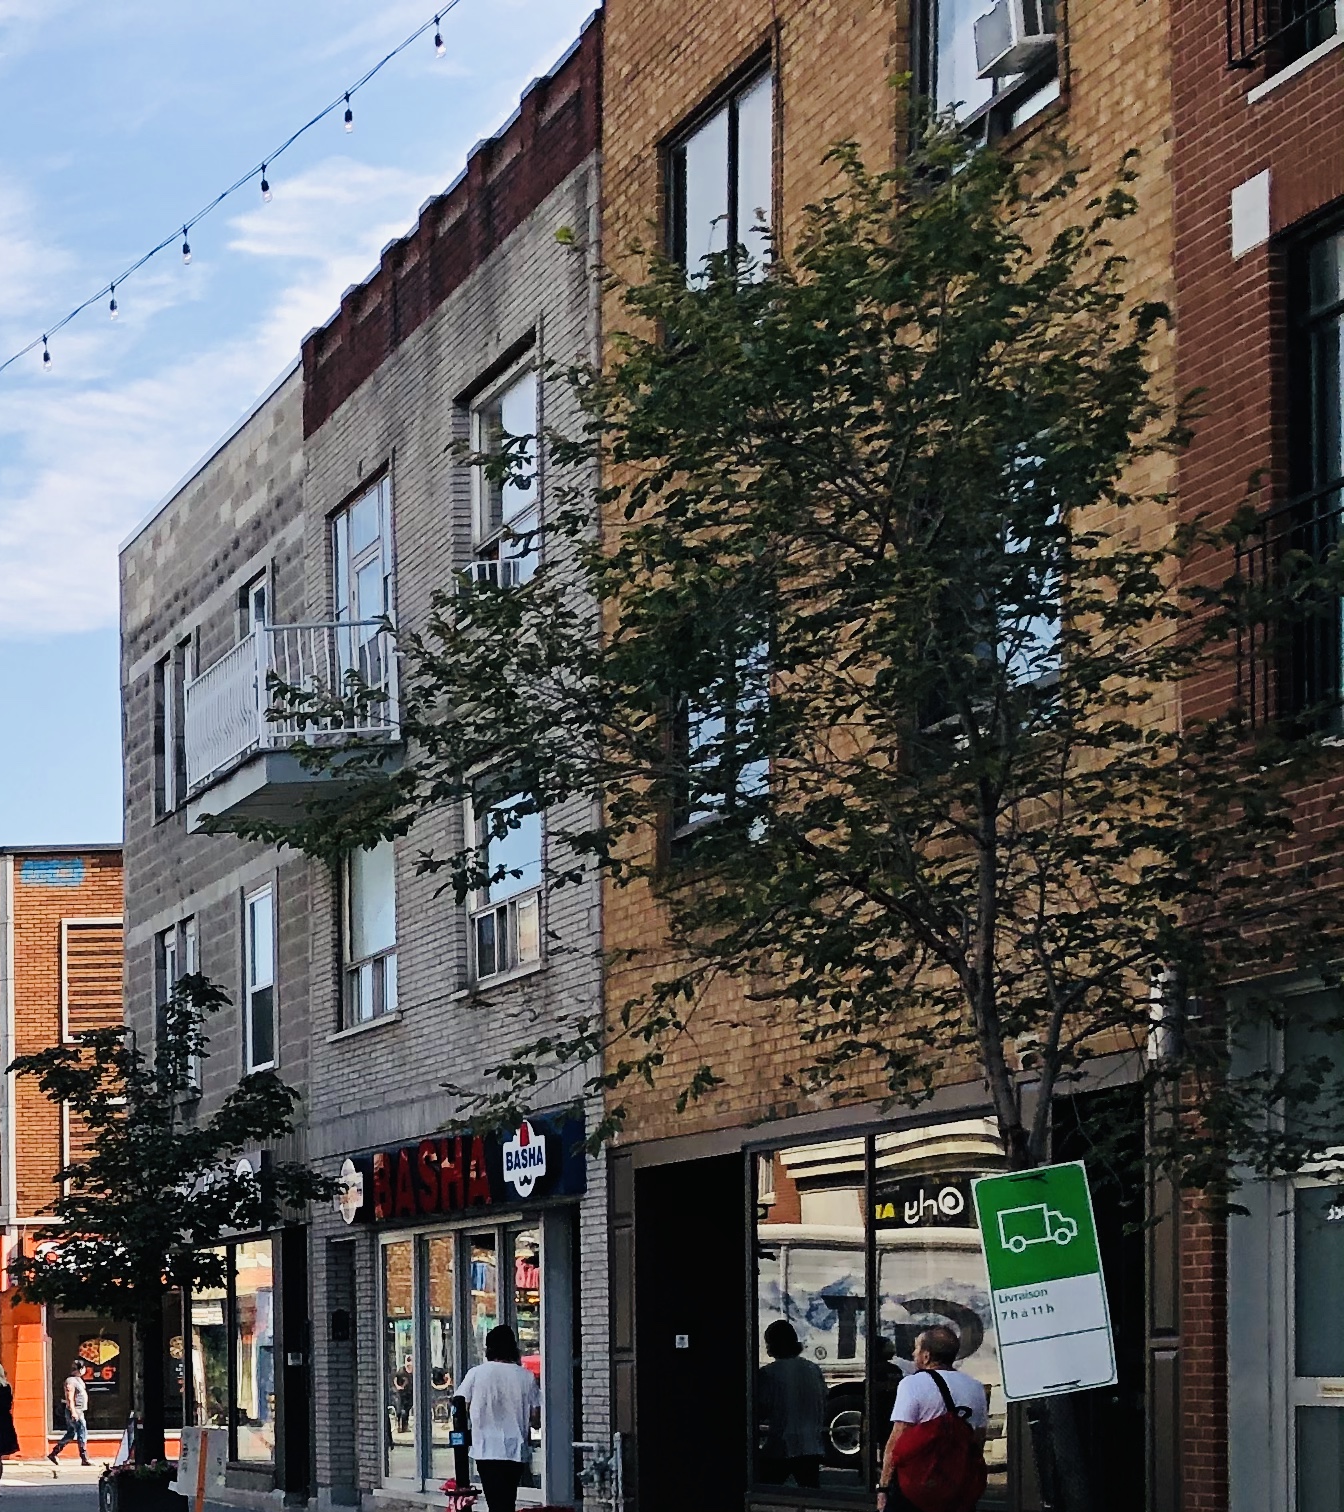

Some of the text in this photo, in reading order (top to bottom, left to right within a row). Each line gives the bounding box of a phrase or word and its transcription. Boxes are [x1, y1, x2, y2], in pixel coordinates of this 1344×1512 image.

[505, 1145, 545, 1172] BASHA
[373, 1133, 494, 1221] BASHA
[998, 1288, 1048, 1304] Livraison
[1001, 1311, 1008, 1320] 7
[1010, 1309, 1018, 1320] h
[1032, 1305, 1043, 1315] 11
[1045, 1303, 1055, 1314] h
